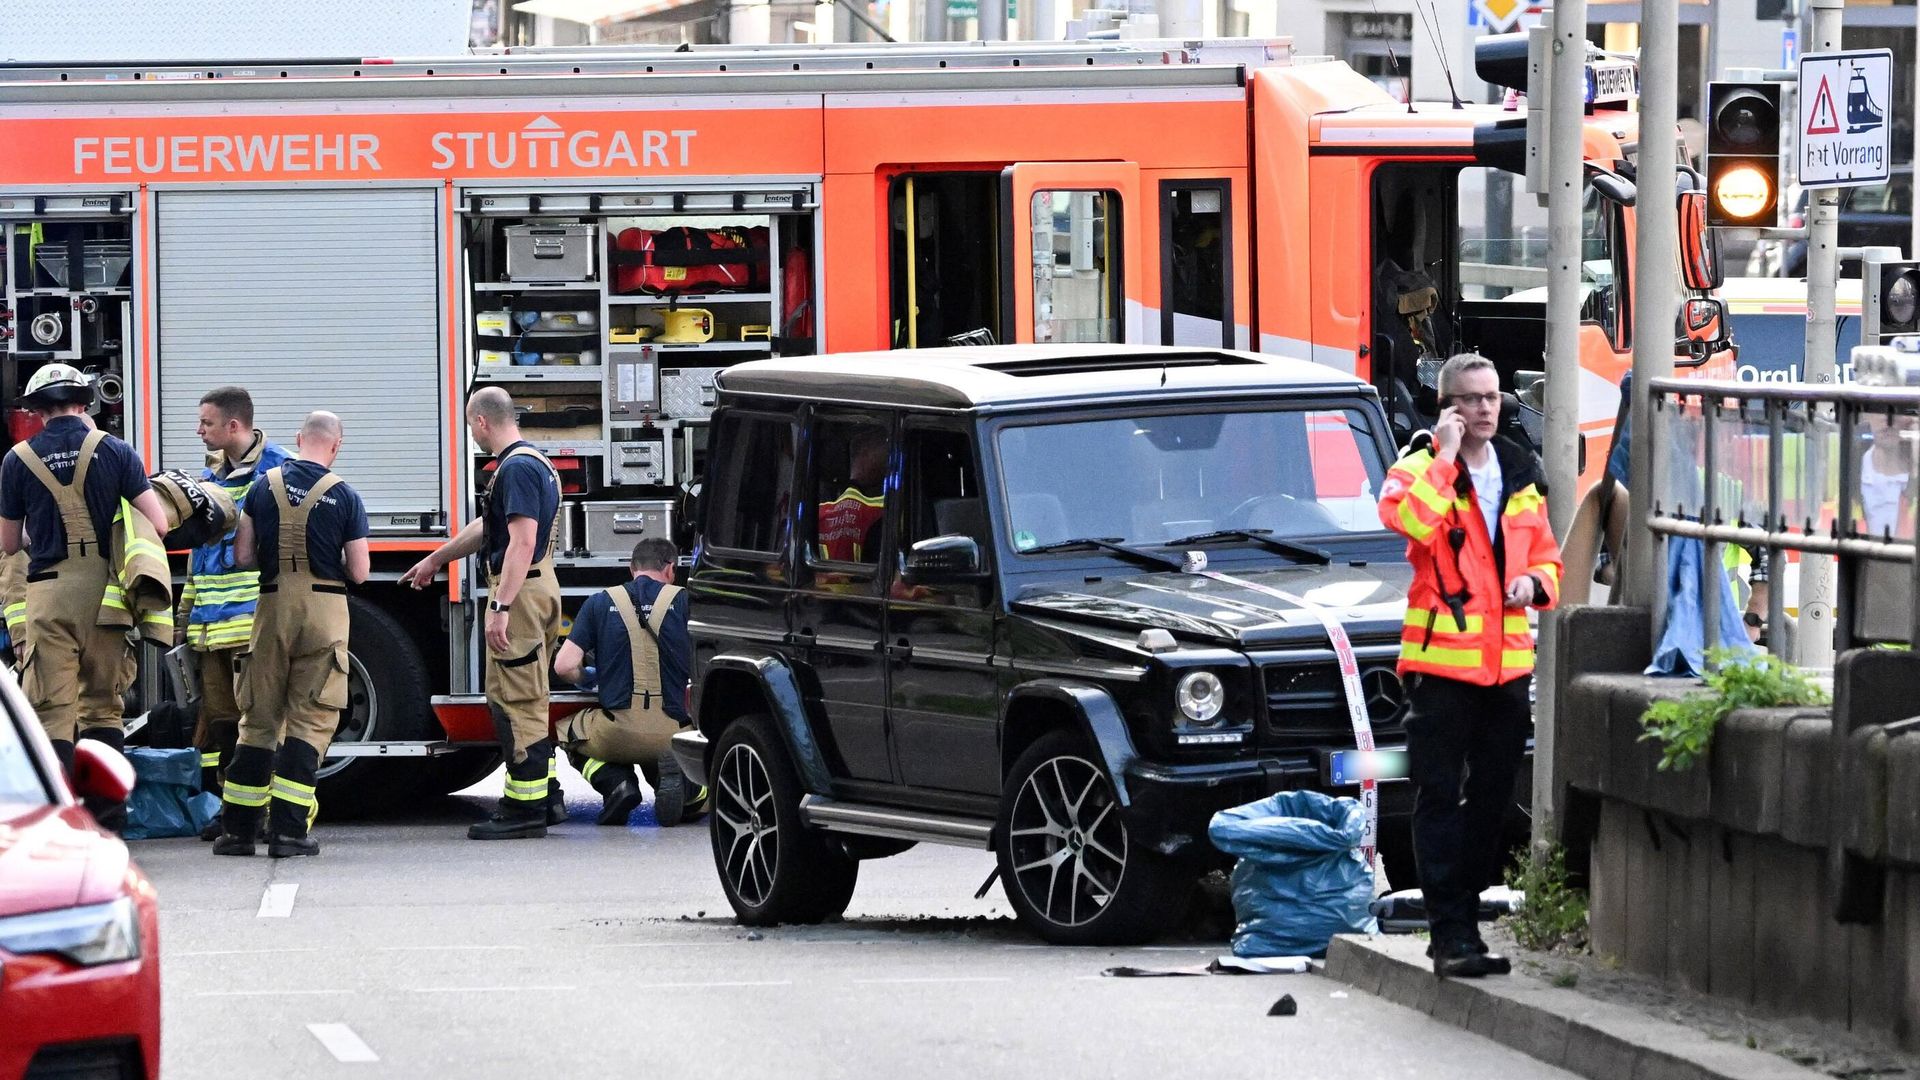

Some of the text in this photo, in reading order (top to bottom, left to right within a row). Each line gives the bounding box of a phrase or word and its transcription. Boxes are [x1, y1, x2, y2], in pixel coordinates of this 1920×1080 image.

[73, 114, 698, 175] FEUERWEHR STUTTGART
[1833, 141, 1883, 171] Vorrang
[1355, 705, 1362, 721] 9
[1366, 791, 1372, 808] 6
[1365, 821, 1371, 836] 5
